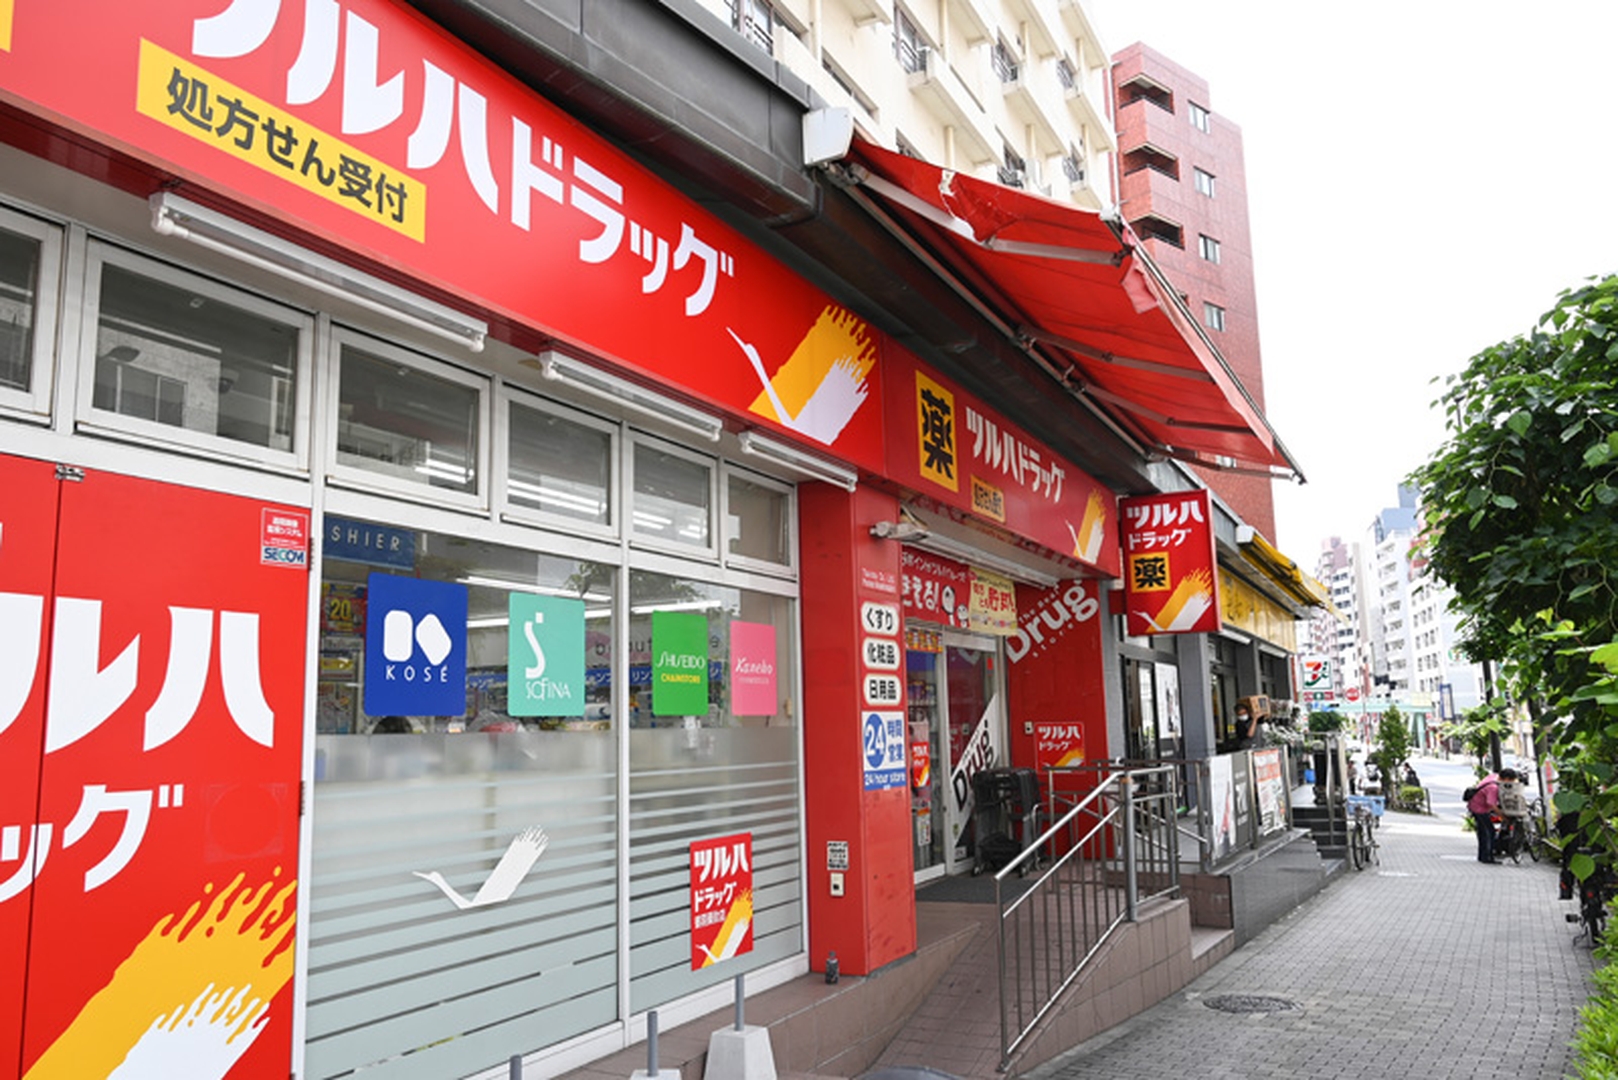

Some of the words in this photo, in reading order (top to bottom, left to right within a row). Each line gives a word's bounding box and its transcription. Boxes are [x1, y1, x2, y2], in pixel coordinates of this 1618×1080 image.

[166, 67, 408, 224] 処方せん受付
[920, 387, 954, 480] 薬
[965, 406, 1066, 503] ツルハドラッグ
[1126, 499, 1205, 529] ツルハ
[1128, 528, 1193, 551] ドラッグ
[264, 547, 304, 564] SECOM
[866, 607, 894, 631] くすり
[1005, 585, 1099, 665] Drug
[867, 641, 895, 664] 化粧品
[385, 664, 449, 684] KOSÉ
[735, 656, 774, 675] Kanebo
[869, 678, 897, 700] 日用品
[865, 724, 885, 757] 24
[1038, 725, 1081, 740] ツルハ
[1039, 740, 1073, 751] ドラッグ
[693, 842, 750, 883] ツルハ
[695, 881, 738, 913] ドラッグ
